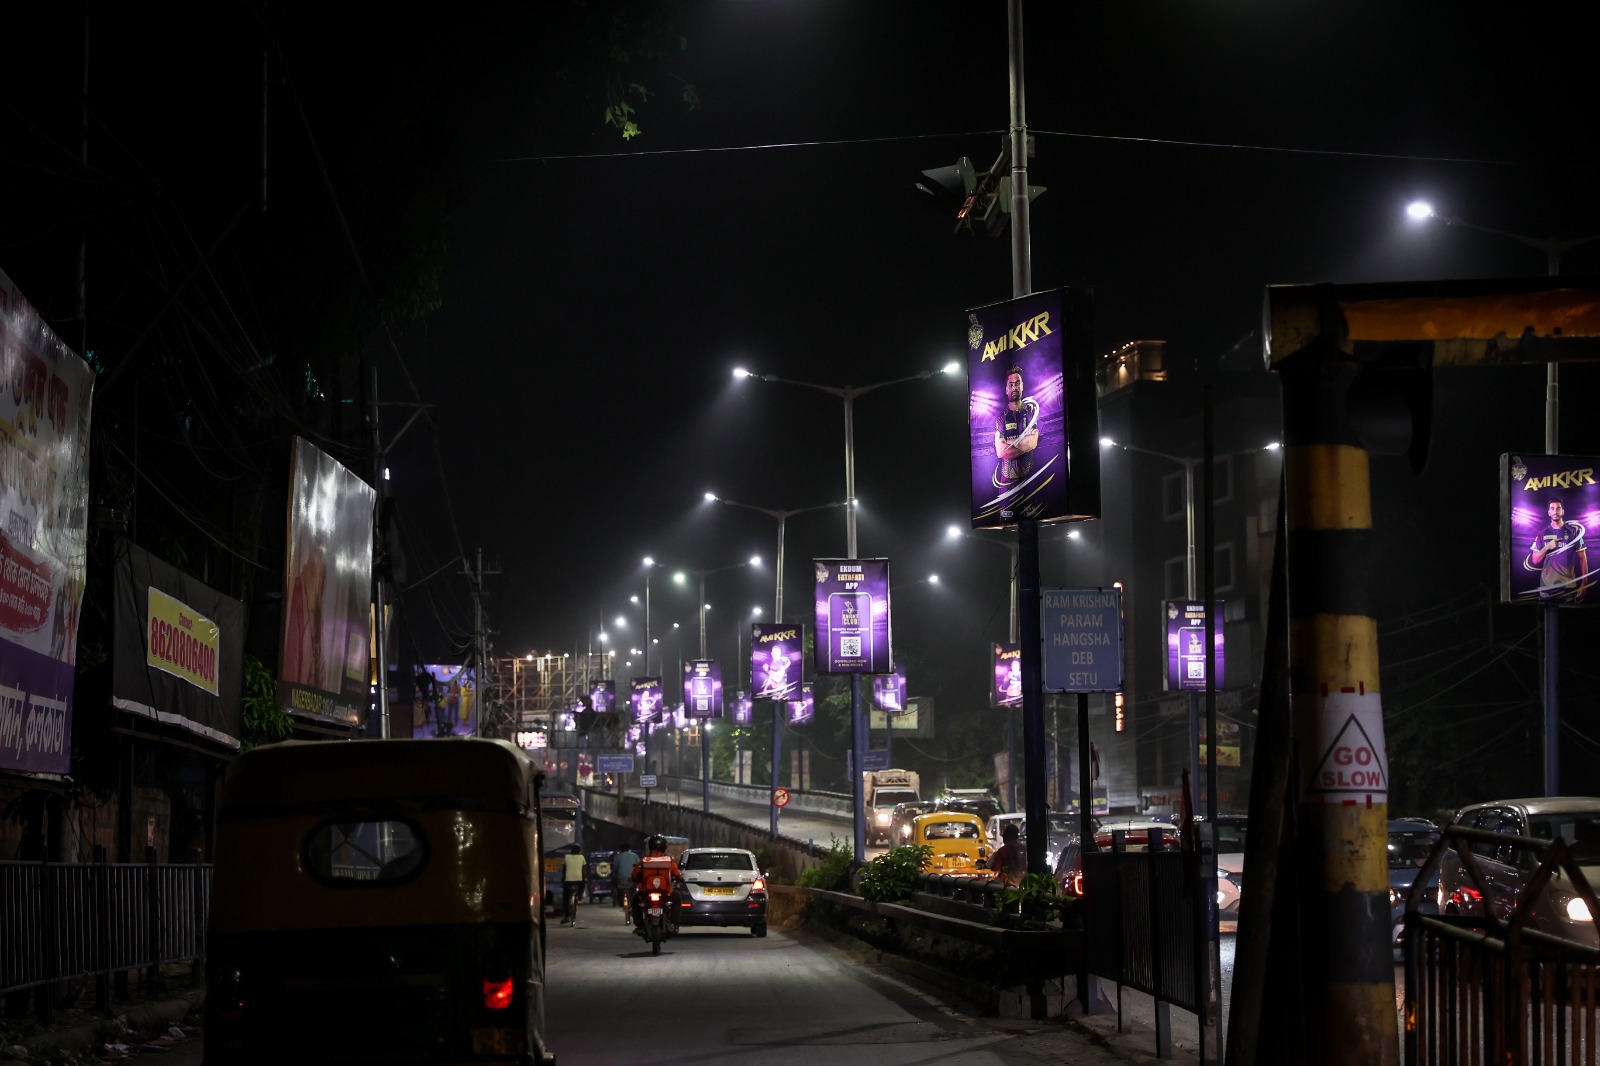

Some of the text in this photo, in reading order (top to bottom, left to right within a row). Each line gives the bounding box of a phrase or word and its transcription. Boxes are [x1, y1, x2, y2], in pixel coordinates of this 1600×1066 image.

[981, 311, 1053, 363] AMI KKR
[1523, 467, 1596, 491] AMI KKR
[839, 565, 862, 573] EKDUM
[845, 582, 859, 590] APP
[1046, 595, 1116, 608] RAM KRISHNA
[1060, 614, 1103, 627] PARAM
[774, 629, 797, 642] KKR
[1053, 632, 1111, 646] HANGSHA
[151, 616, 215, 683] 8620806400
[1071, 651, 1094, 665] DEB
[1069, 672, 1098, 686] SETU
[25, 693, 67, 755] কলকাতা
[1333, 746, 1372, 766] GO
[1321, 770, 1381, 787] SLOW
